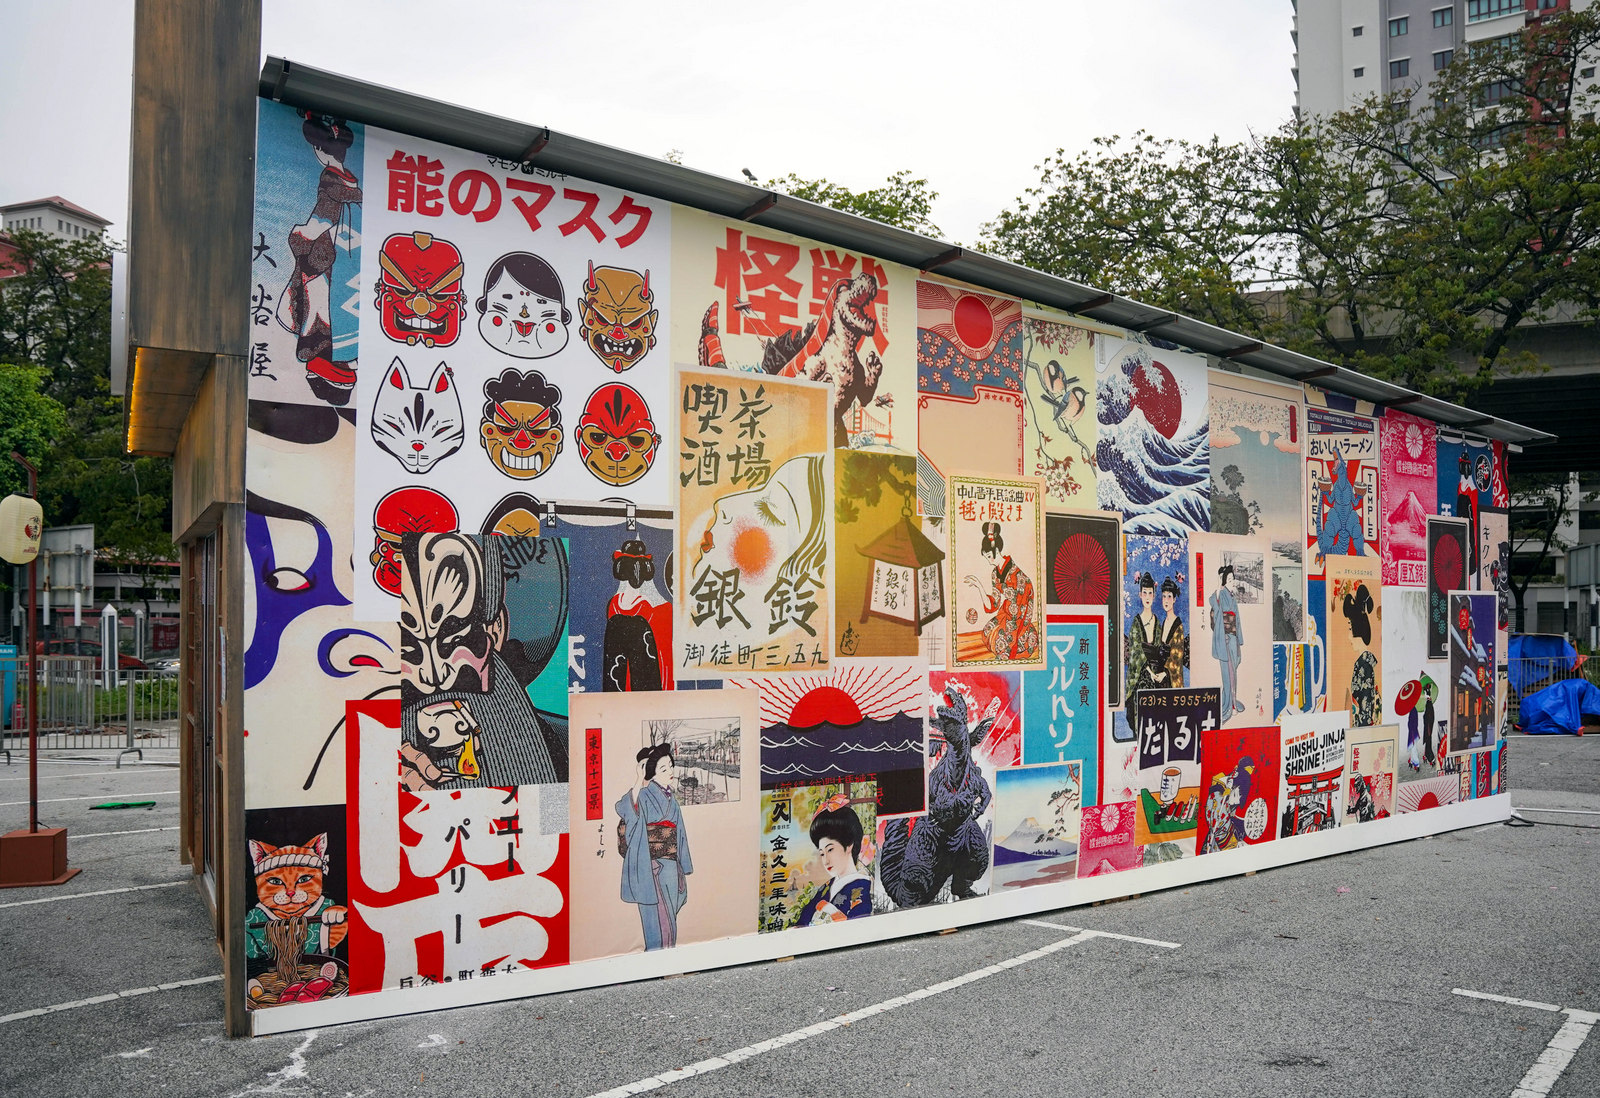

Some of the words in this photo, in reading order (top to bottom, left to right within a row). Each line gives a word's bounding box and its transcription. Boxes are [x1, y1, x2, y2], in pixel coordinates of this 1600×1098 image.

[386, 150, 653, 249] 能のマスク
[714, 227, 889, 357] 怪獣
[683, 383, 773, 440] 喫茶
[680, 437, 771, 489] 酒場
[1310, 438, 1373, 455] おいしいラーメン
[959, 499, 1023, 522] 毬と殿さま
[1025, 491, 1035, 502] XV
[1311, 470, 1319, 526] RAMEN
[690, 564, 825, 637] 銀鈴
[1079, 637, 1090, 707] 新發賣
[1173, 695, 1201, 706] 5955
[588, 734, 599, 811] 東京十二景
[1285, 737, 1318, 761] JINSHU
[1320, 728, 1345, 749] JINJA
[445, 818, 471, 944] パリー
